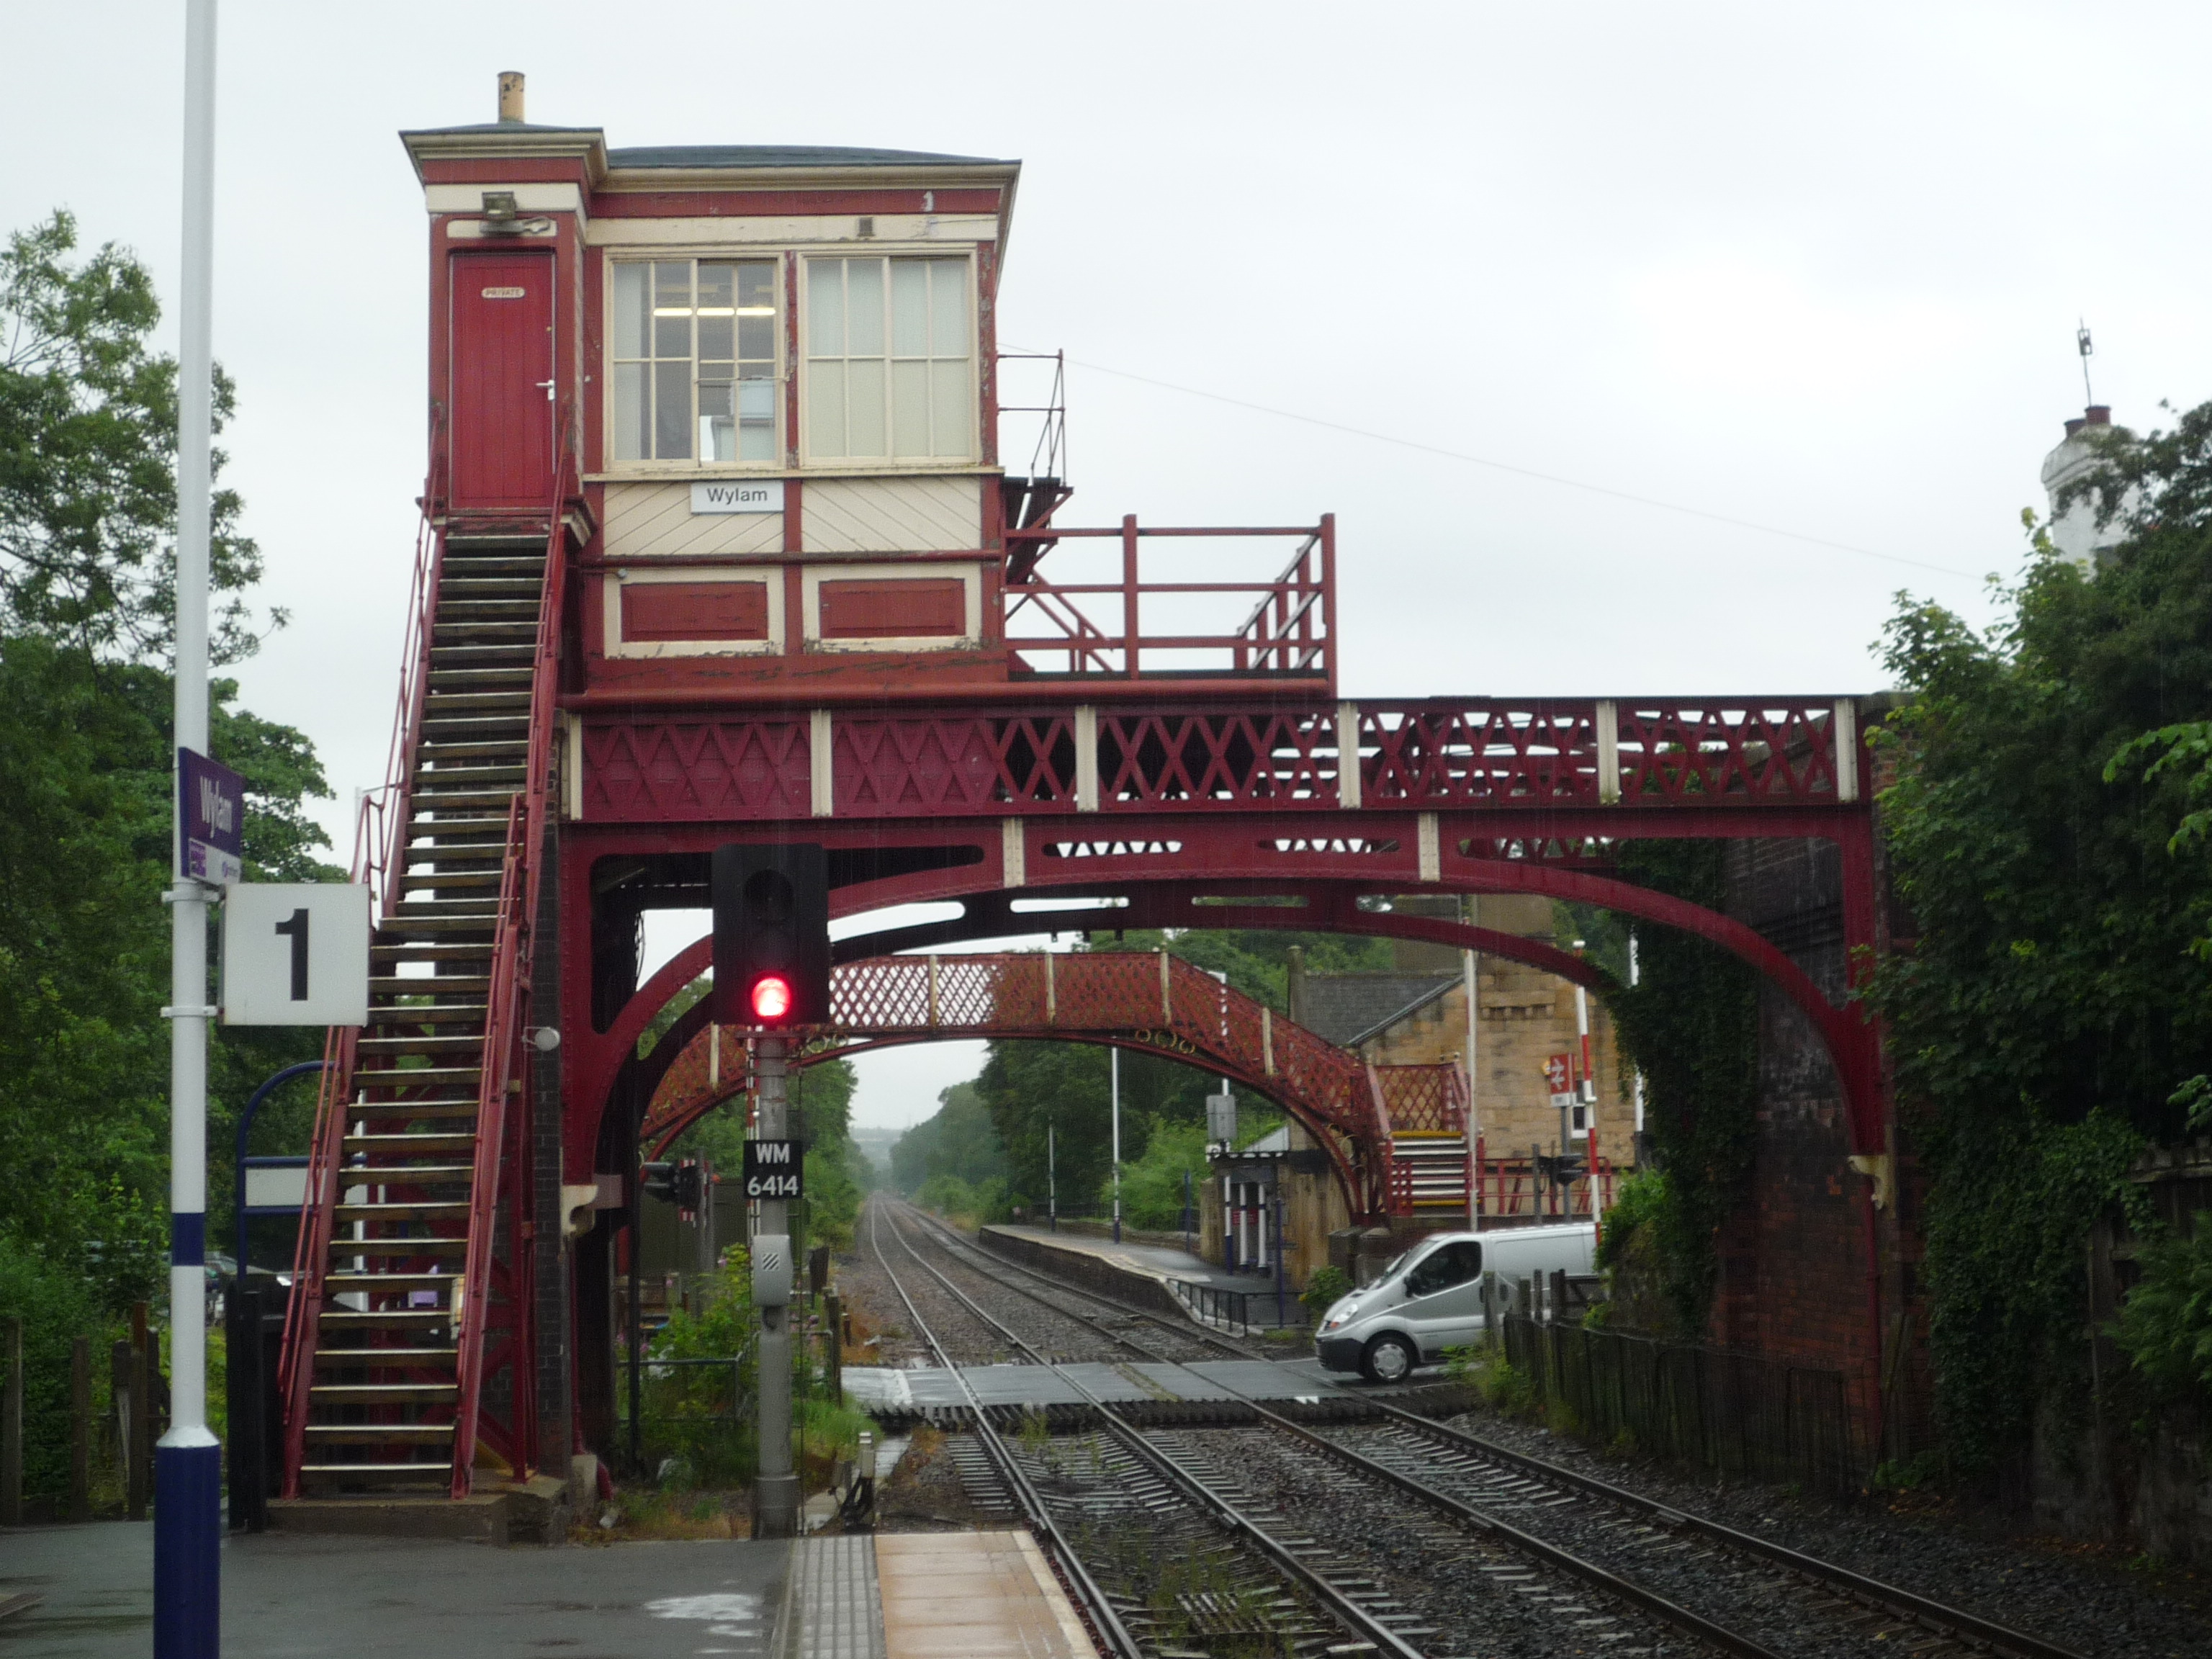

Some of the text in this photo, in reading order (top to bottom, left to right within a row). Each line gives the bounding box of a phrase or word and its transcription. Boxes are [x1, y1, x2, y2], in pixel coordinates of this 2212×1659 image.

[706, 487, 768, 505] Wylam
[199, 775, 233, 839] Wylam
[275, 908, 309, 1002] 1
[755, 1143, 790, 1164] WM
[747, 1175, 799, 1196] 6414
